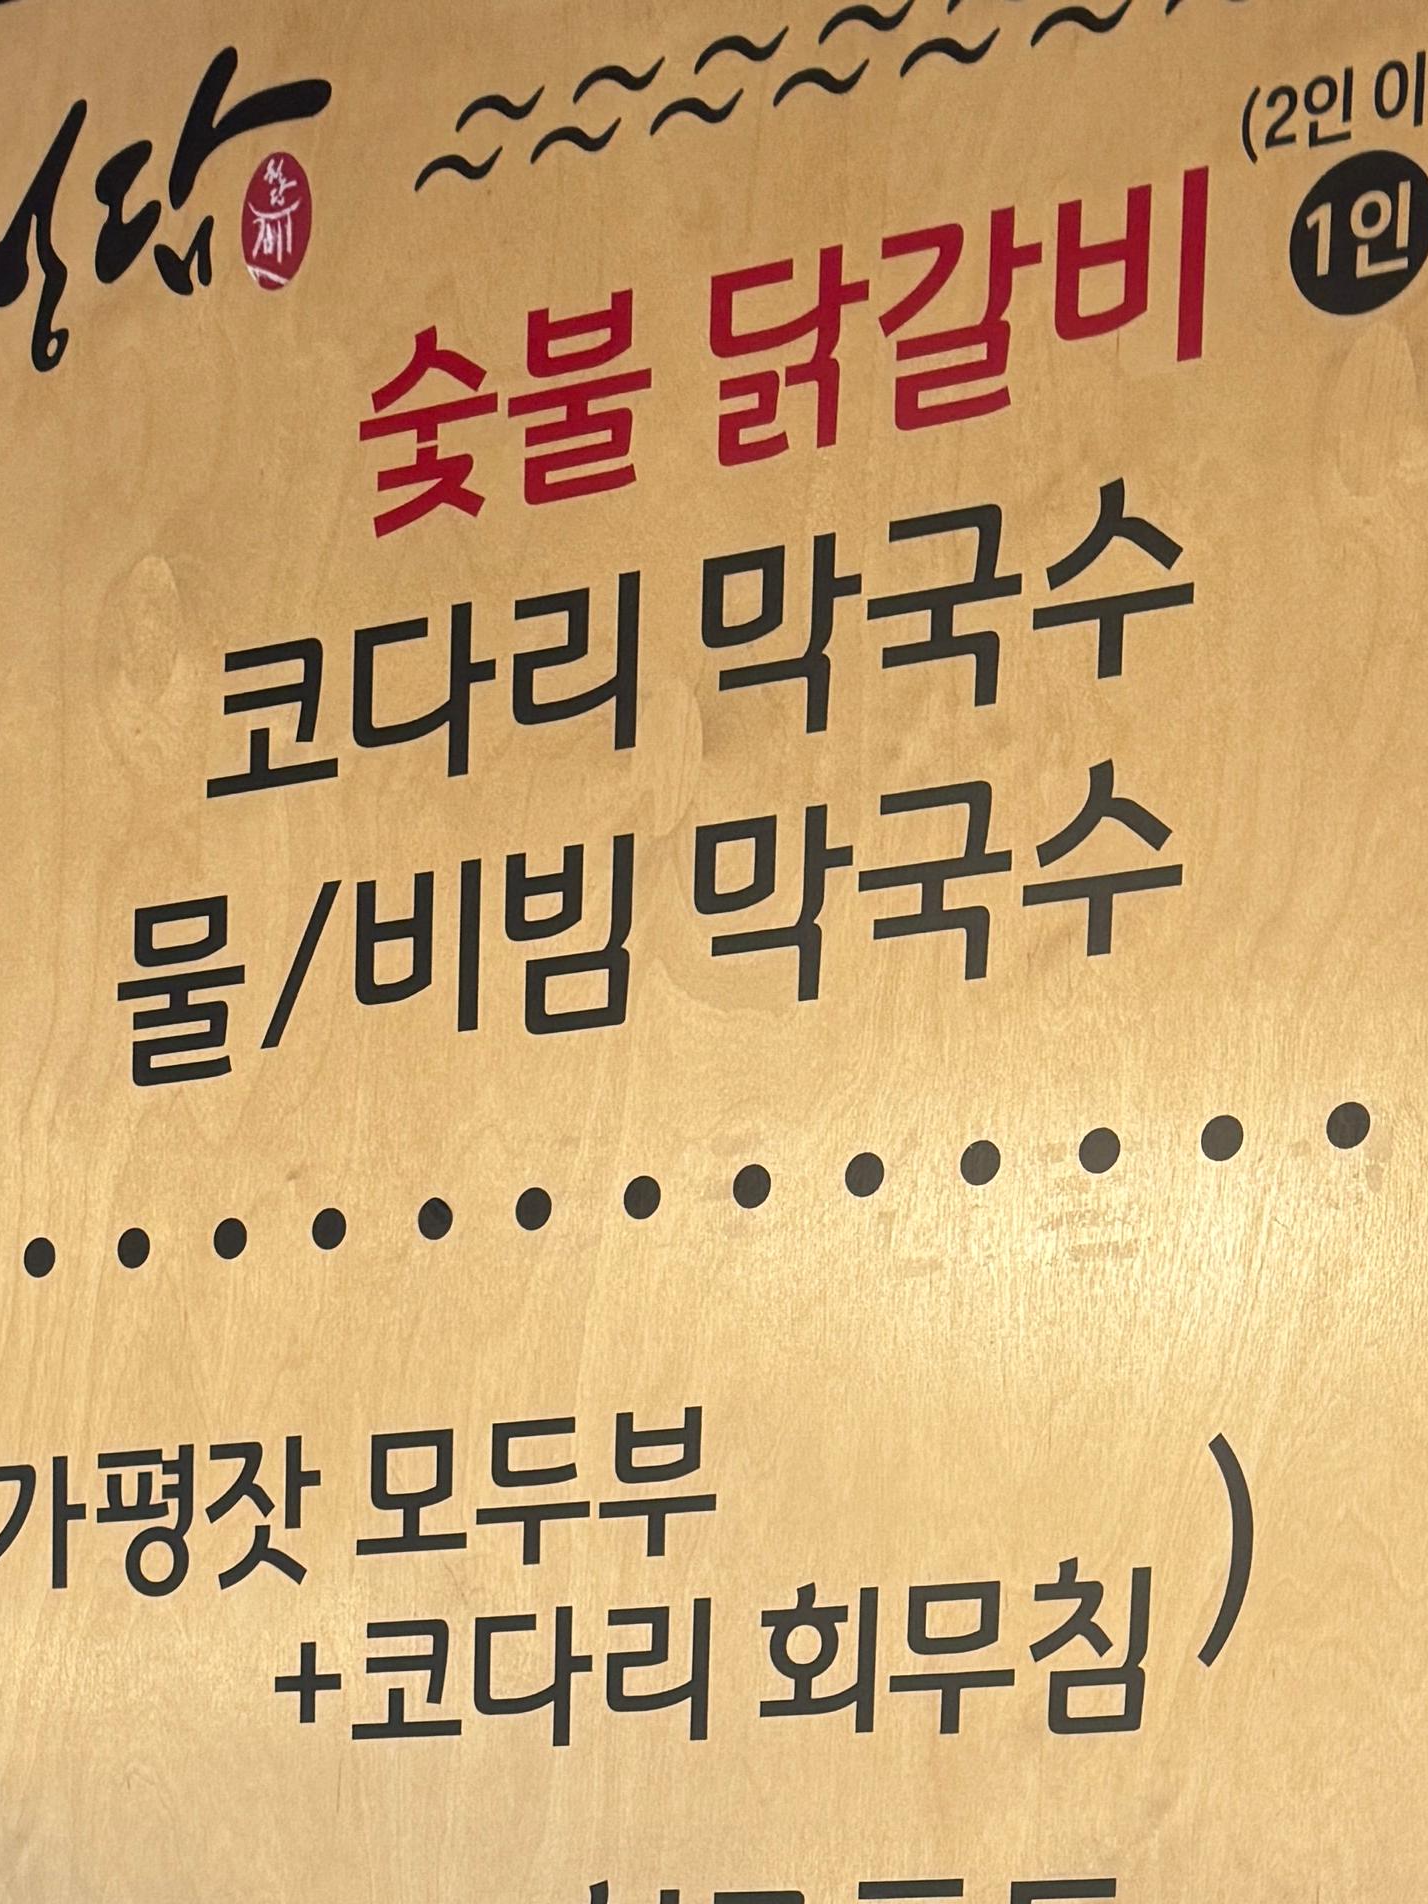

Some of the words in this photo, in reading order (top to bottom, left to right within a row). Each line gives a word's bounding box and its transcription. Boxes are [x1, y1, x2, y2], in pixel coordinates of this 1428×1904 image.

[1241, 66, 1355, 163] (2인
[360, 289, 651, 537] 숯불
[710, 167, 1208, 466] 닭갈비
[1307, 180, 1411, 278] 1인
[207, 571, 640, 798] 코다리
[702, 478, 1194, 733] 막국수
[118, 833, 634, 1086] 물/비빔
[694, 759, 1182, 1001] 막국수
[357, 1407, 716, 1565] 모두부
[275, 1598, 711, 1746] +코다리
[760, 1558, 1151, 1734] 회무침
